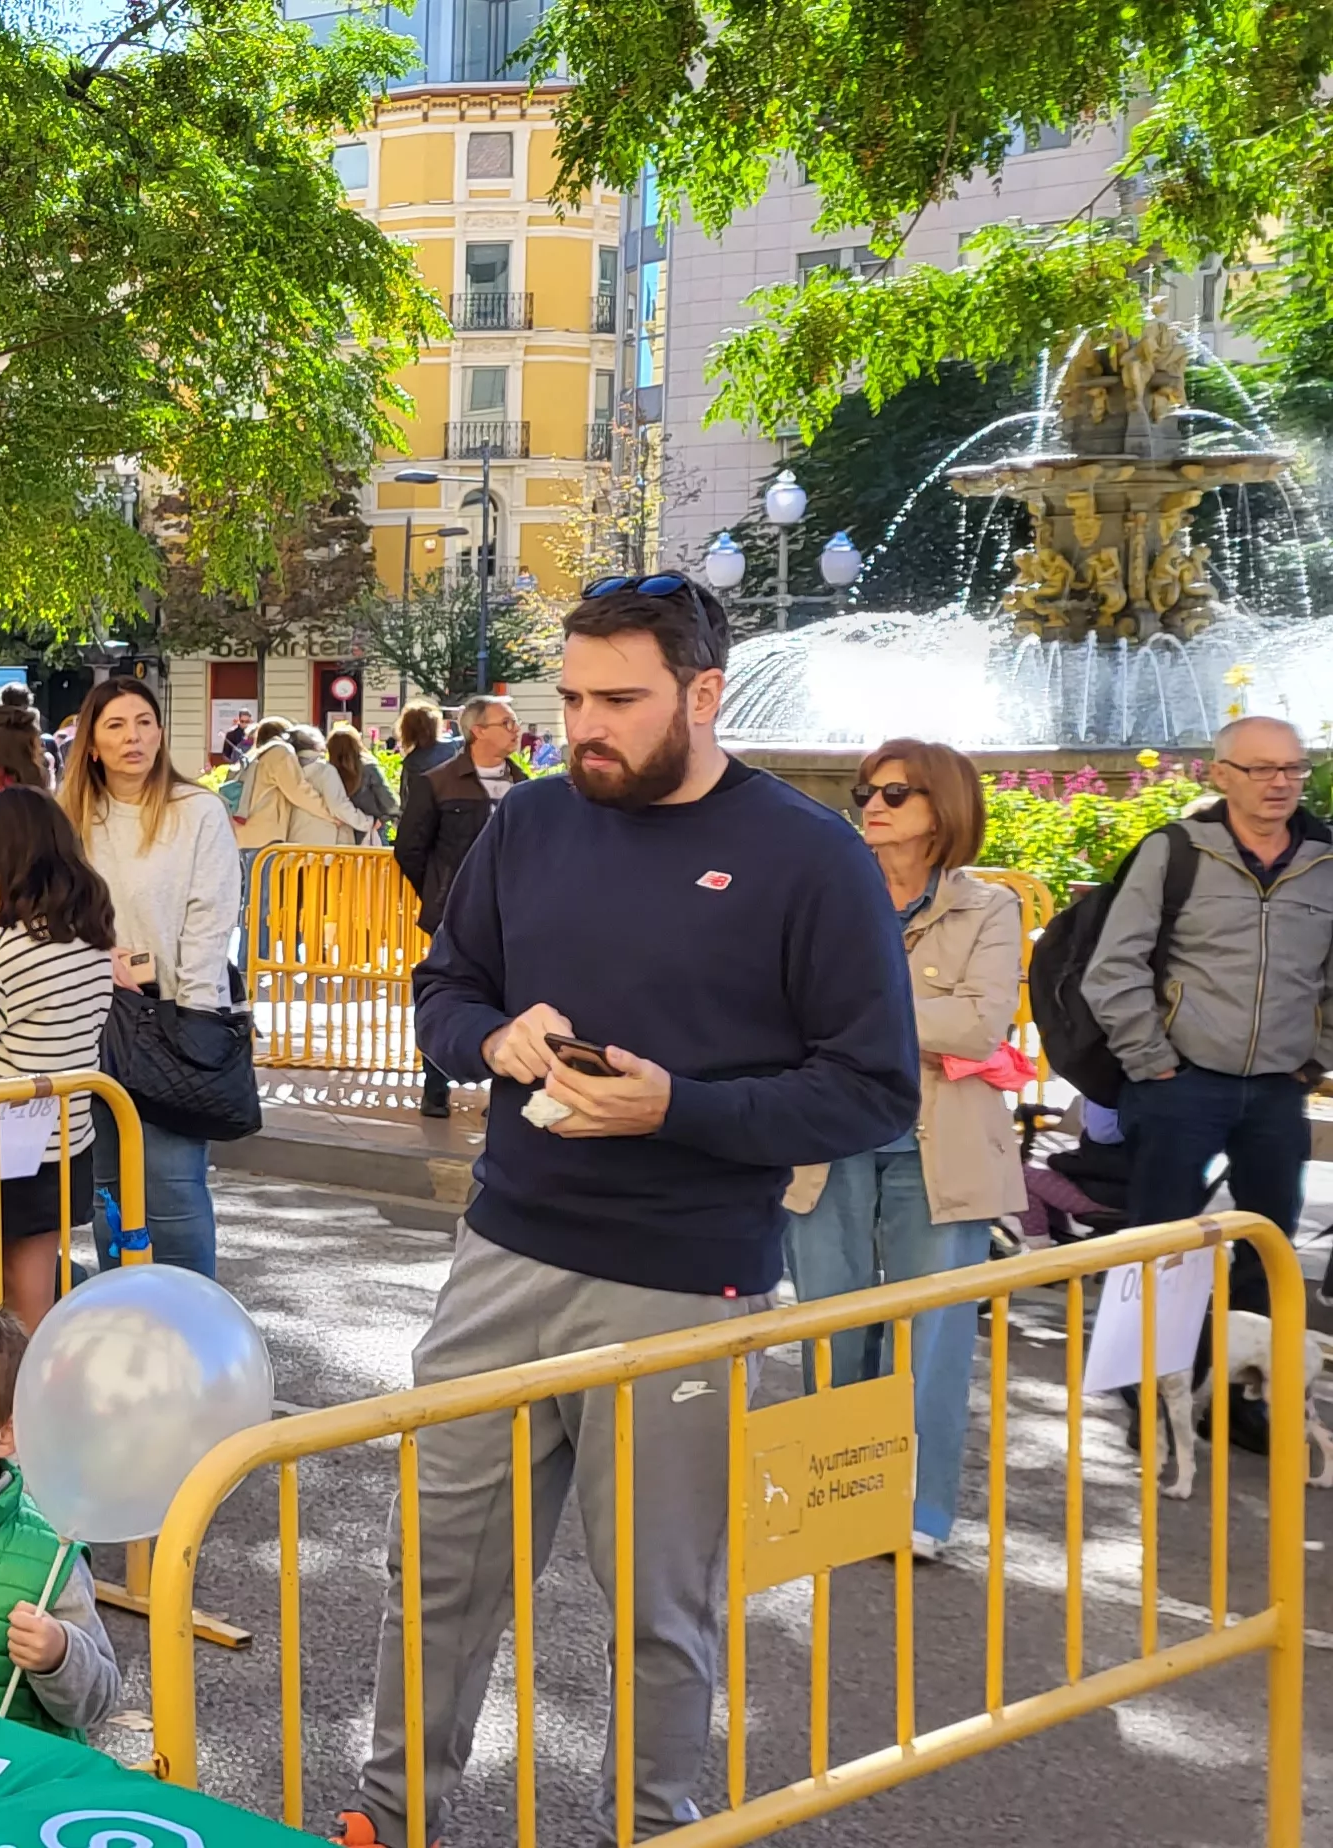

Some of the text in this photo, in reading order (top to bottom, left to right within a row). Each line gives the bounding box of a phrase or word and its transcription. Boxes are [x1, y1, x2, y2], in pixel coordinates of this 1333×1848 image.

[809, 1435, 908, 1480] Ayuntamiento
[807, 1473, 885, 1508] de Huesca
